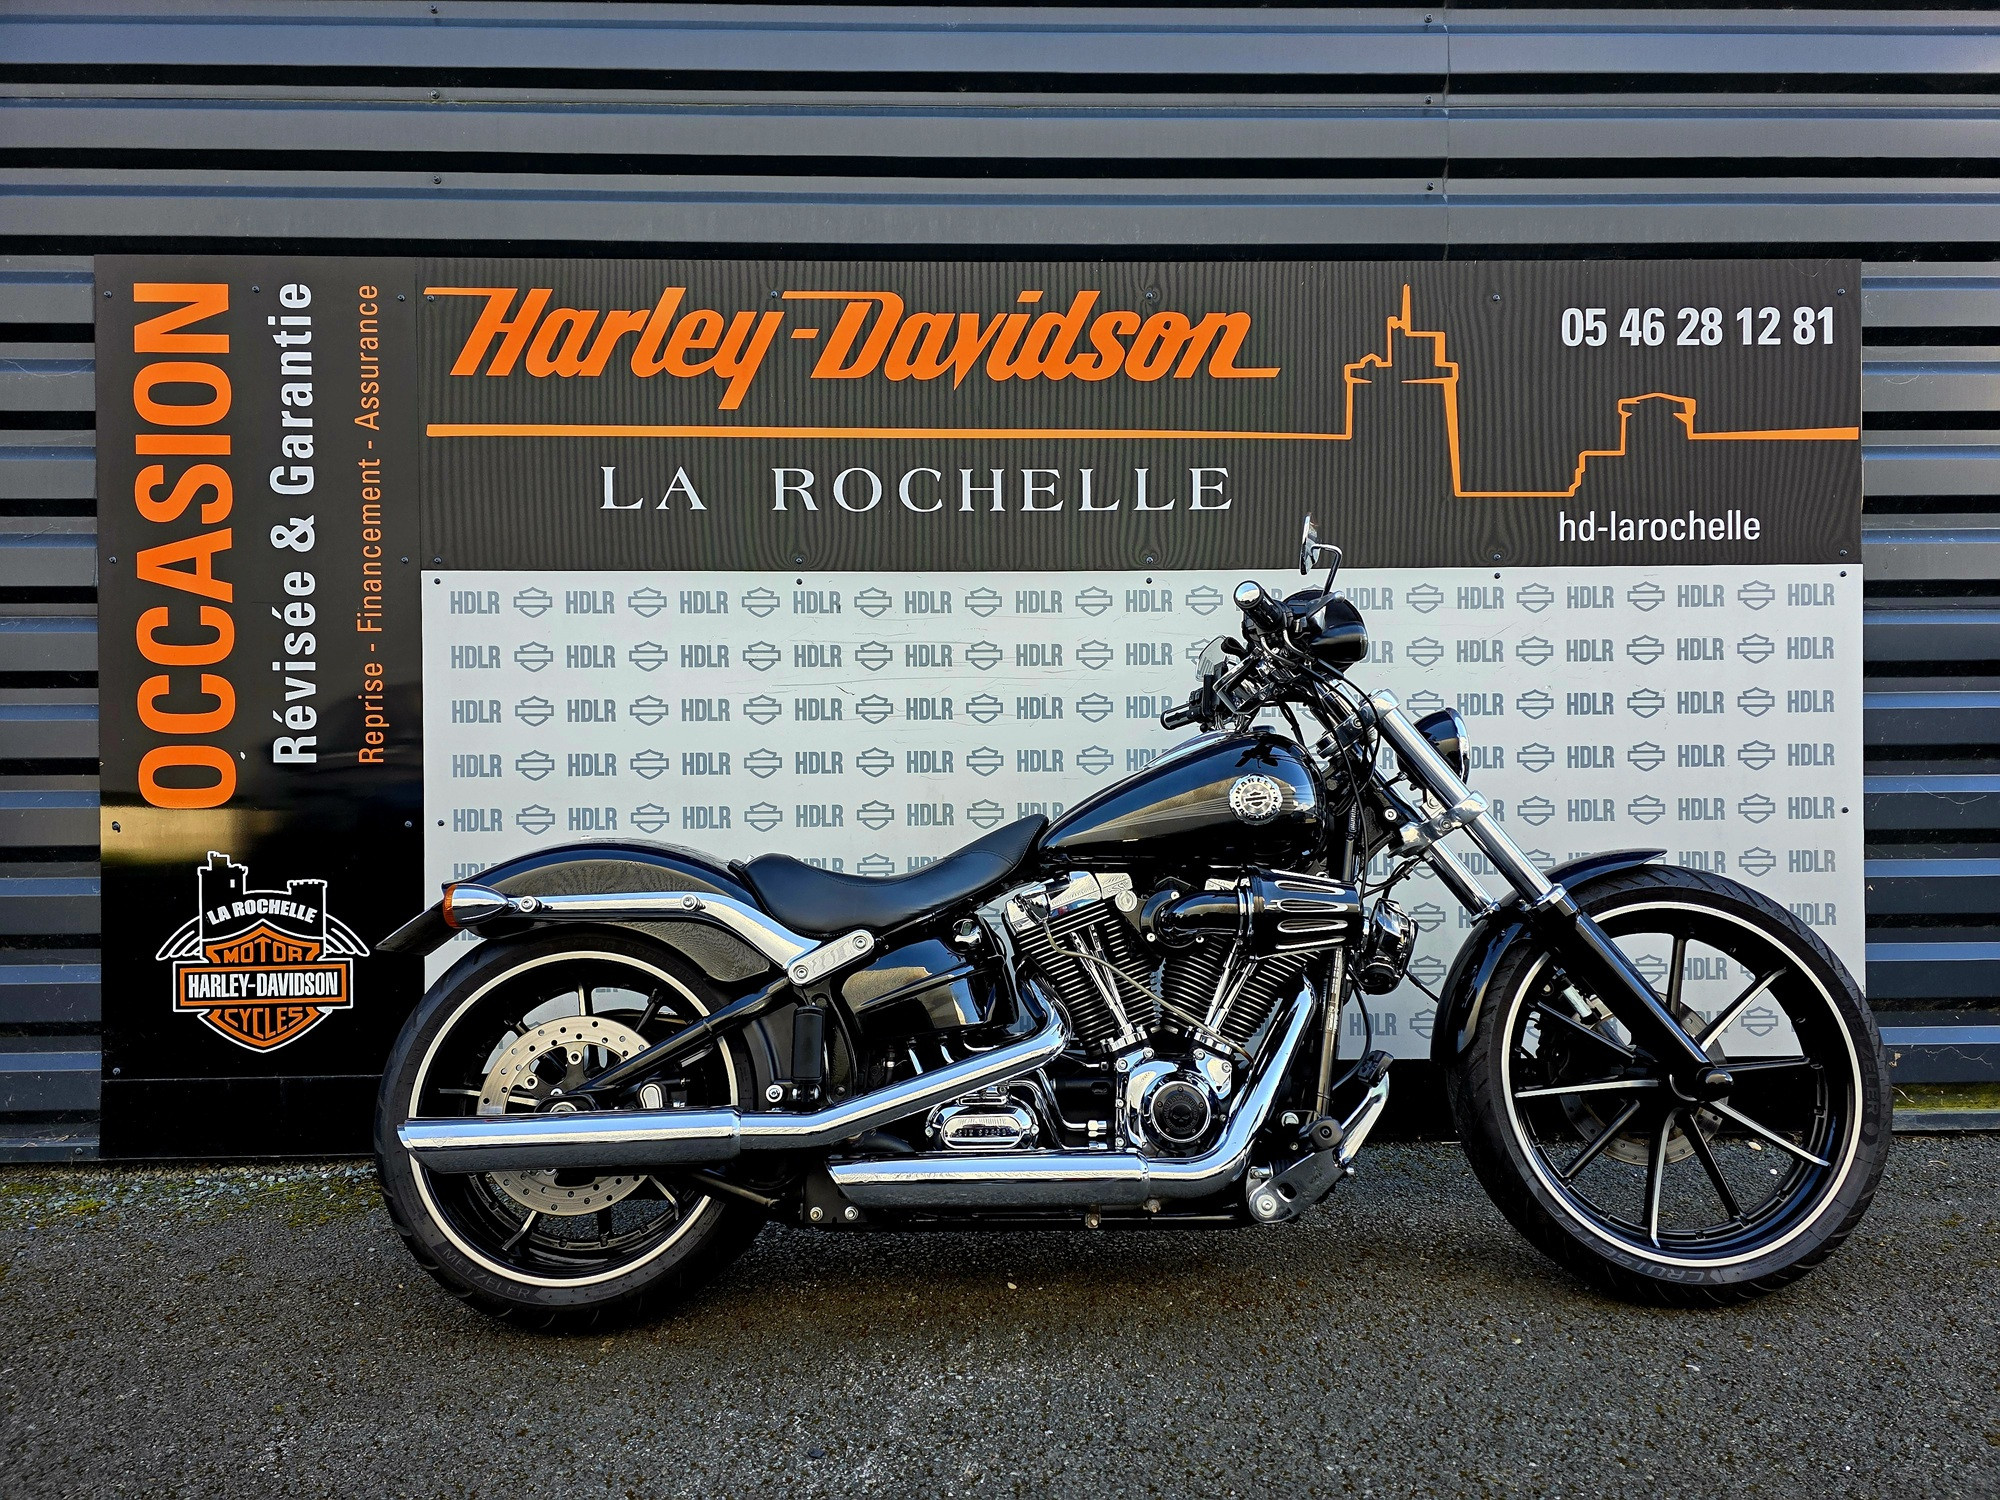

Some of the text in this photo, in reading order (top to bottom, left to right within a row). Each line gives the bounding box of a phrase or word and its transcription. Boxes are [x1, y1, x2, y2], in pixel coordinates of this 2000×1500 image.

[1561, 306, 1834, 346] 05 46 28 12 81
[354, 284, 381, 431] Assurance
[424, 287, 1280, 409] Harley-Davidson
[600, 466, 1233, 513] LA ROCHELLE
[267, 283, 318, 764] Révisée & Garantie
[1559, 509, 1761, 542] hd-larochelle
[132, 282, 238, 809] OCCASION
[356, 458, 383, 634] Financement
[450, 590, 501, 615] HDLR
[565, 590, 616, 615] HDLR
[679, 590, 729, 614] HDLR
[792, 590, 842, 615] HDLR
[904, 590, 953, 614] HDLR
[1015, 590, 1063, 614] HDLR
[1125, 589, 1173, 613] HDLR
[1456, 586, 1505, 610] HDLR
[1566, 585, 1615, 610] HDLR
[1677, 584, 1725, 608] HDLR
[1787, 582, 1836, 607] HDLR
[450, 636, 1835, 669] HDLR HDLR HDLR HDLR HDLR HDLR HDLR LR HDLR HDLR HDLR HDLR
[358, 663, 390, 764] Reprise
[451, 699, 502, 724] HDLR
[566, 698, 617, 723] HDLR
[681, 698, 731, 722] HDLR
[794, 697, 844, 722] HDLR
[905, 697, 954, 721] HDLR
[1016, 696, 1064, 720] HDLR
[1456, 692, 1505, 716] HDLR
[1566, 692, 1615, 716] HDLR
[1676, 690, 1725, 715] HDLR
[1787, 689, 1835, 714] HDLR
[452, 742, 1836, 778] HDLR HDLR HDLR HDLR HDLR HDLR HD DLR HDLR HDLR HDLR
[453, 808, 503, 833] HDLR
[568, 807, 618, 831] HDLR
[682, 805, 732, 830] HDLR
[795, 804, 844, 828] HDLR
[906, 802, 955, 827] HDLR
[1567, 798, 1616, 823] HDLR
[1677, 797, 1726, 821] HDLR
[1787, 796, 1836, 820] HDLR
[1458, 853, 1498, 875] HDL
[1788, 849, 1837, 873] HDLR
[206, 898, 318, 926] LA ROCHELLE
[223, 936, 303, 964] MOTOR
[187, 971, 339, 998] HARLEY-DAVIDSON
[224, 1006, 304, 1040] CYCLES
[442, 1247, 531, 1299] METZELER
